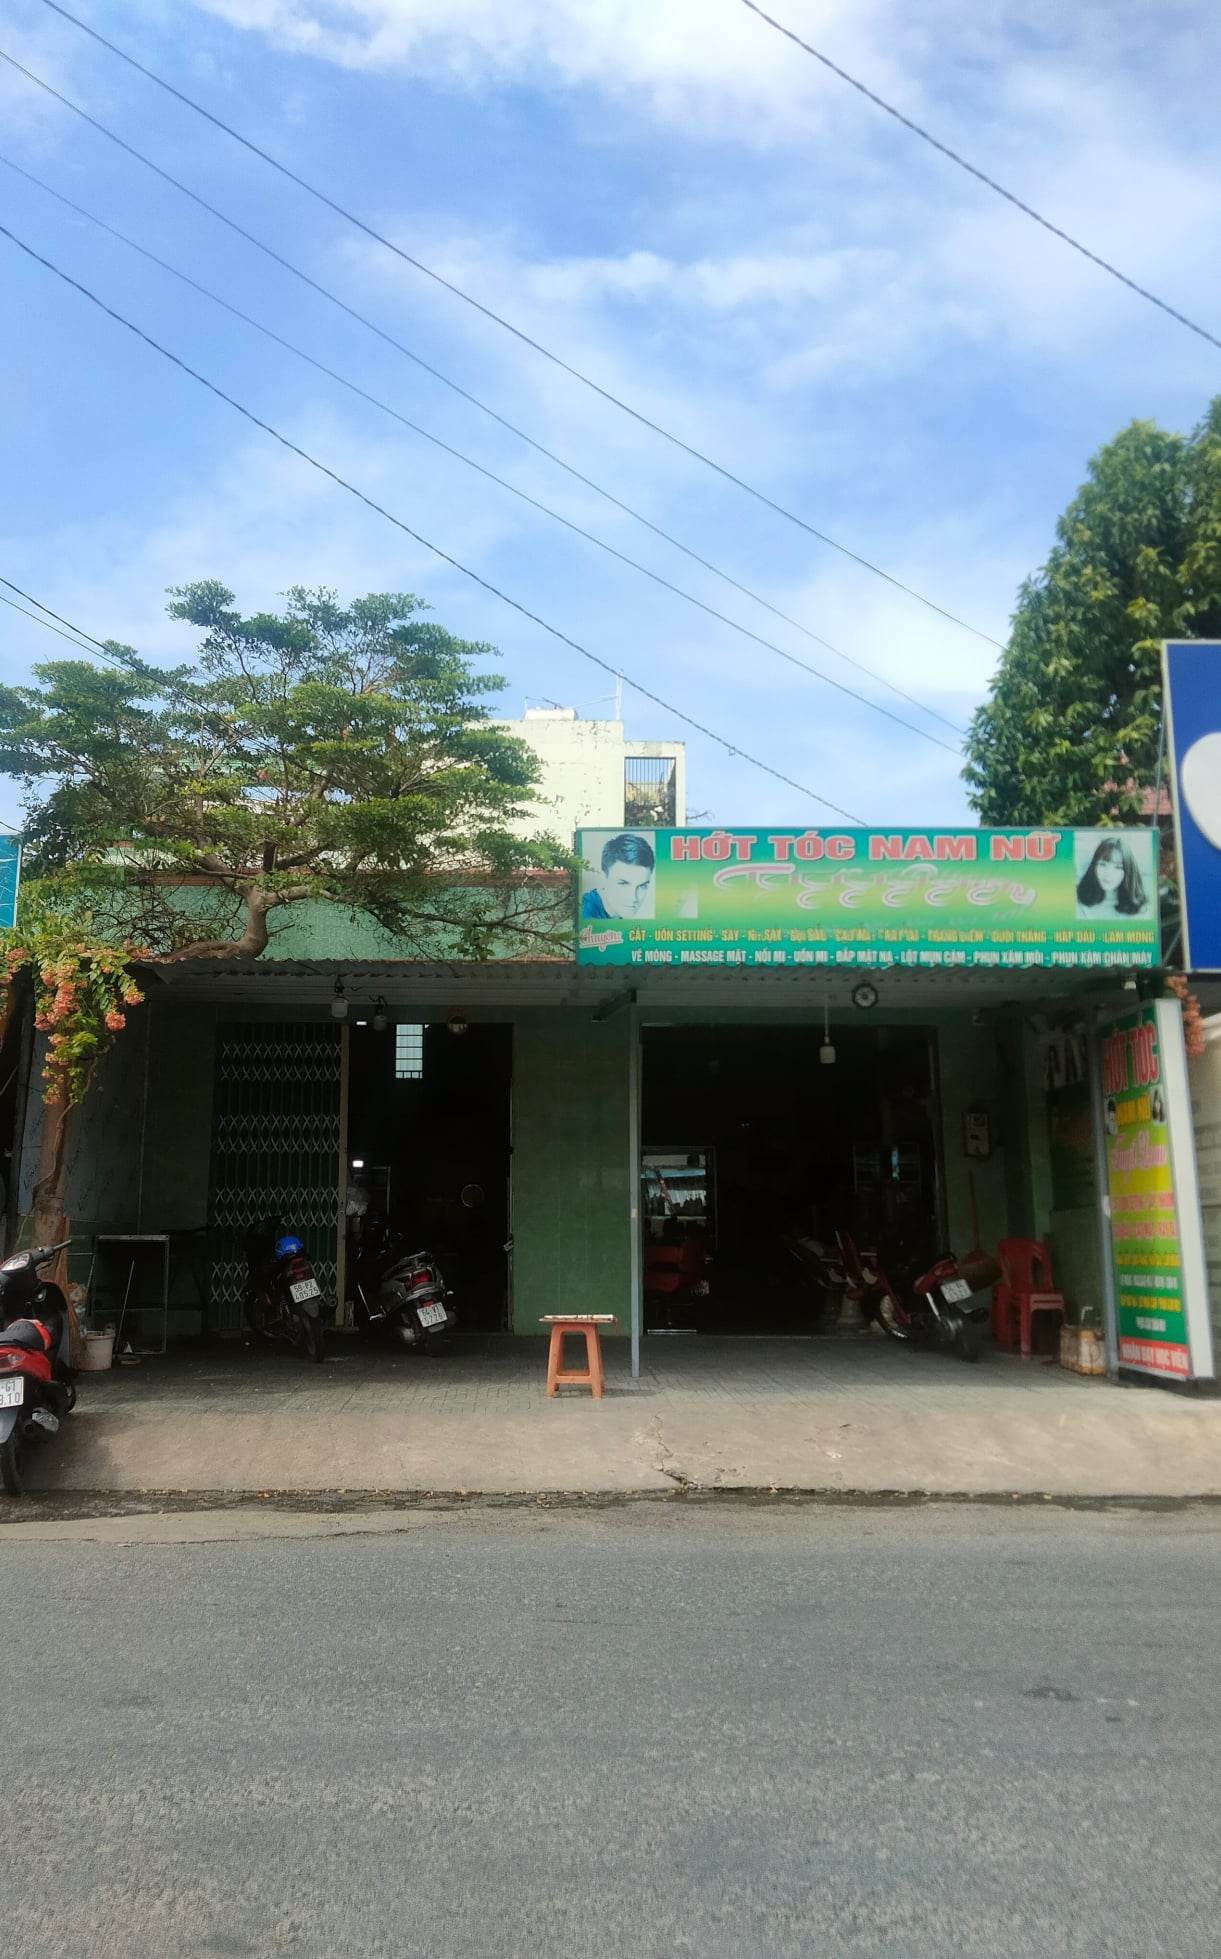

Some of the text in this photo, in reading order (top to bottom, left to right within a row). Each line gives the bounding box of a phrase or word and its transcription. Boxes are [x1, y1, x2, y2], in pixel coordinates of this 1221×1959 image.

[670, 830, 1061, 861] HỚT TÓC NAM NỮ
[645, 949, 672, 962] MÓNG
[681, 950, 724, 962] MASSAGE
